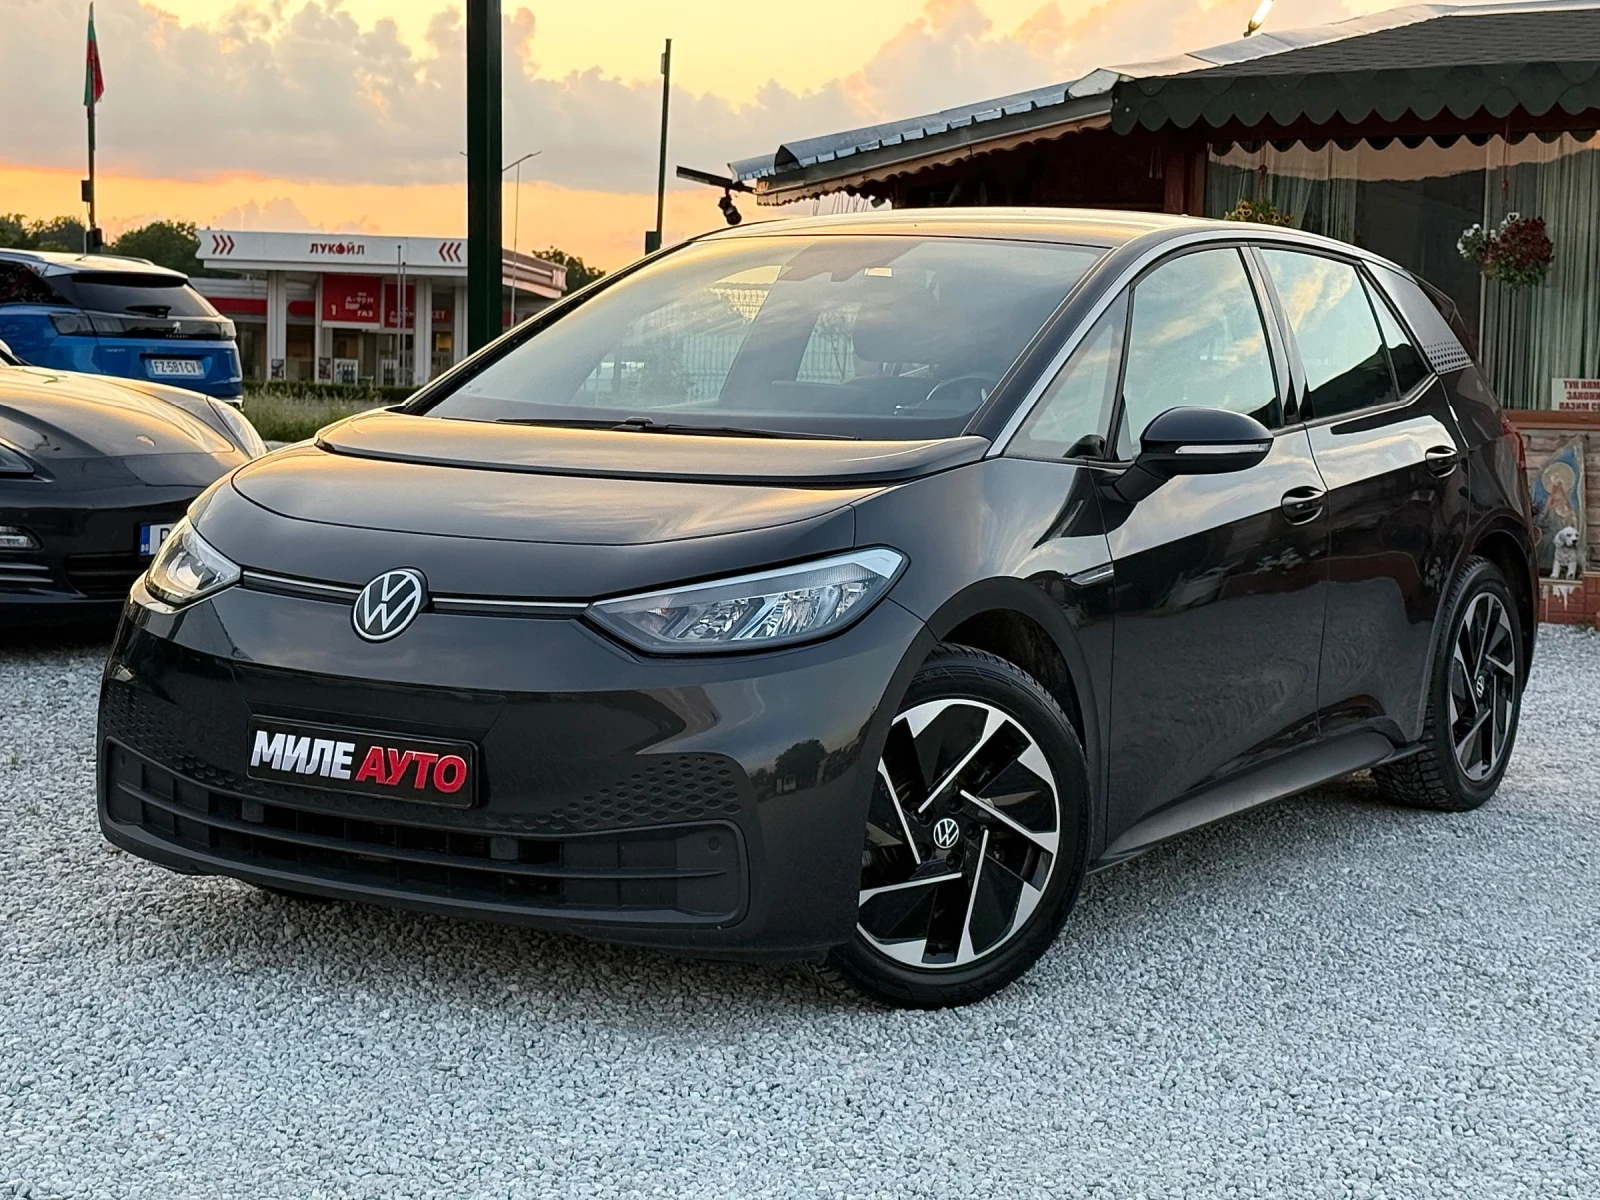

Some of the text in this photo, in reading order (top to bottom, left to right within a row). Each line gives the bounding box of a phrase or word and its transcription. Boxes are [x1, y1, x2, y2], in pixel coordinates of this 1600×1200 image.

[309, 241, 365, 255] ЛУКОЙЛ
[250, 730, 467, 793] МИЛЕ АУТО
